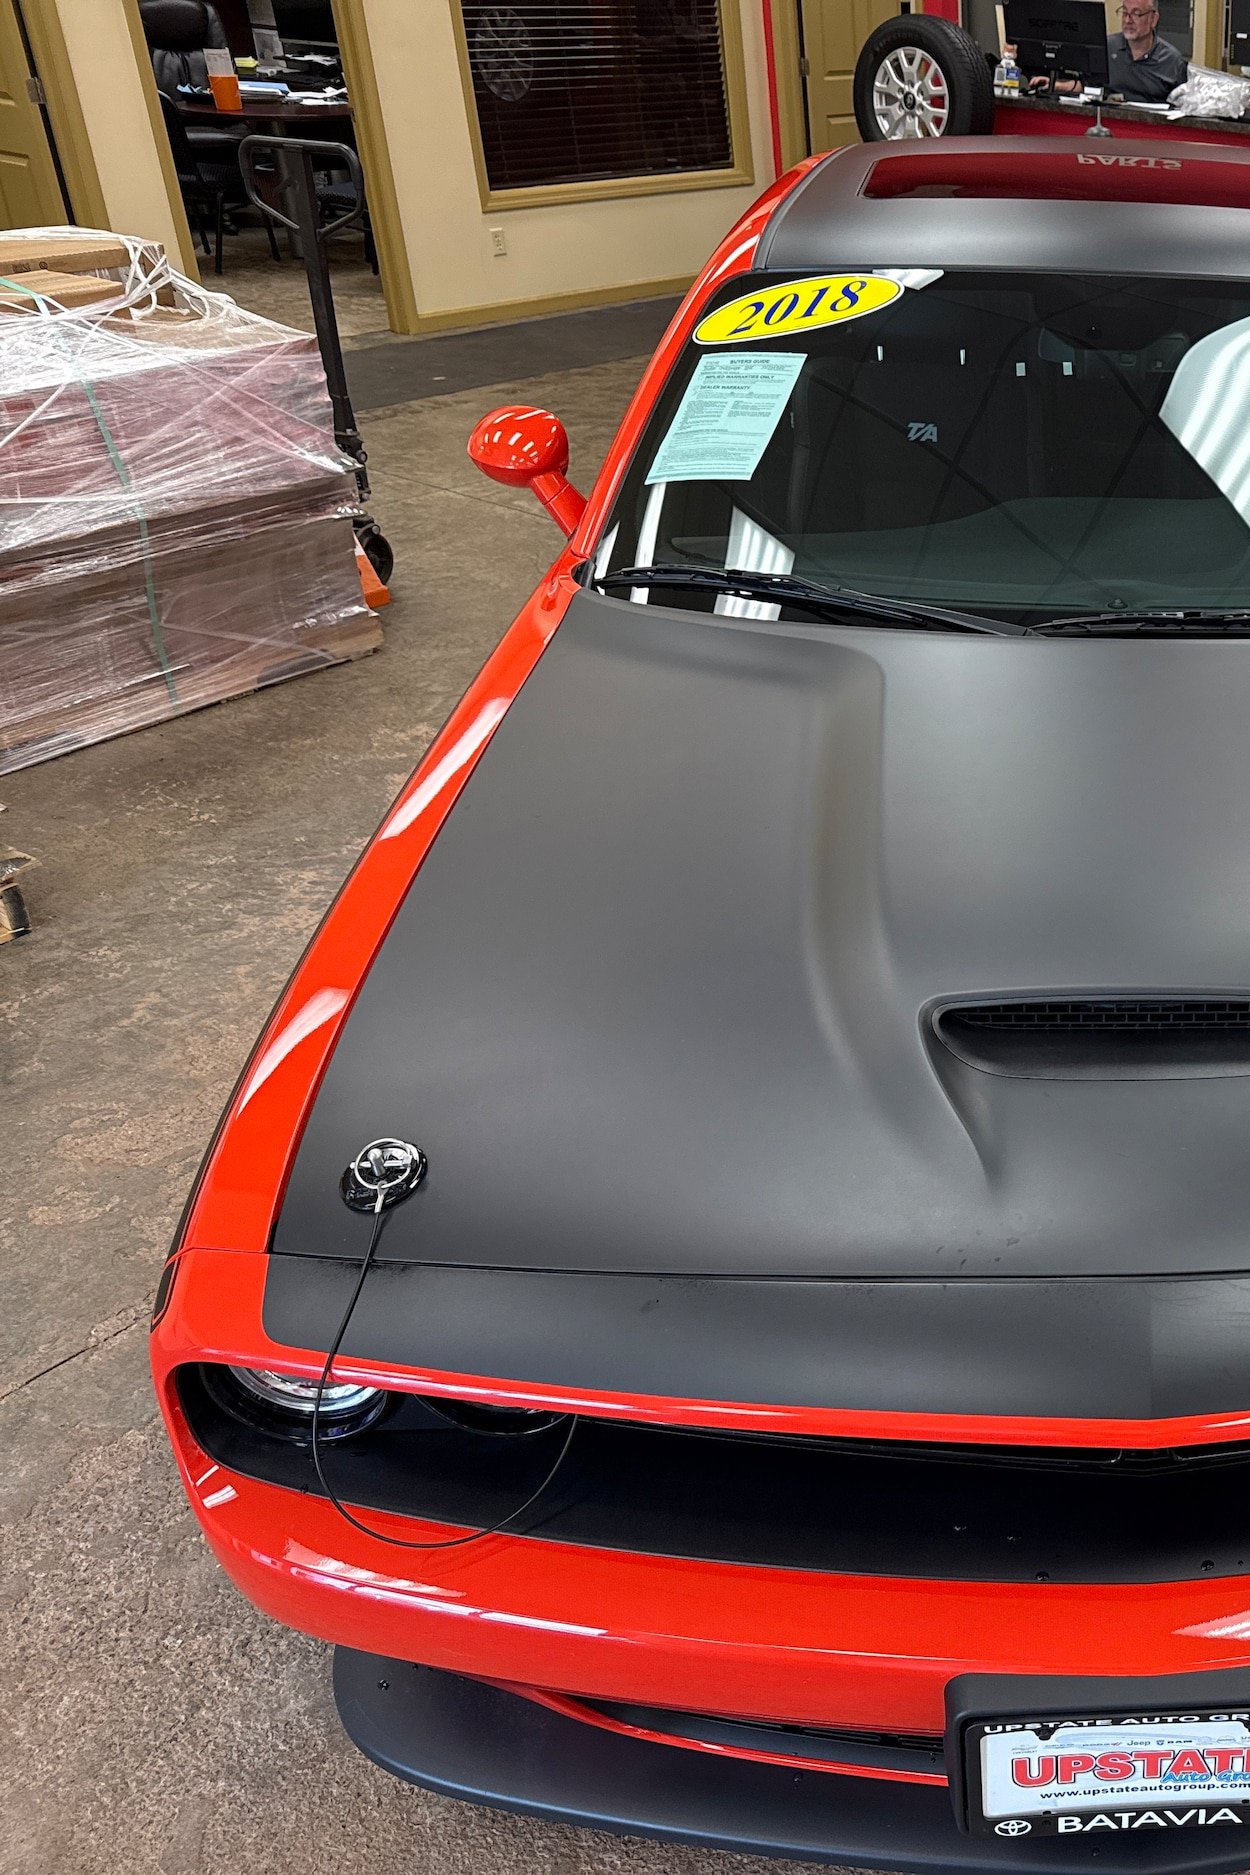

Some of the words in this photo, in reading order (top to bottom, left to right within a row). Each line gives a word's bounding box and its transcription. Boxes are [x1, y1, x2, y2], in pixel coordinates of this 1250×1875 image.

[726, 281, 867, 336] 2018
[984, 1719, 1112, 1733] UPSTATE
[1120, 1715, 1200, 1725] AUTO
[1160, 1771, 1211, 1783] Auto
[1040, 1781, 1250, 1799] www.upstateautogroup.com
[1058, 1807, 1243, 1833] BATAVIA
